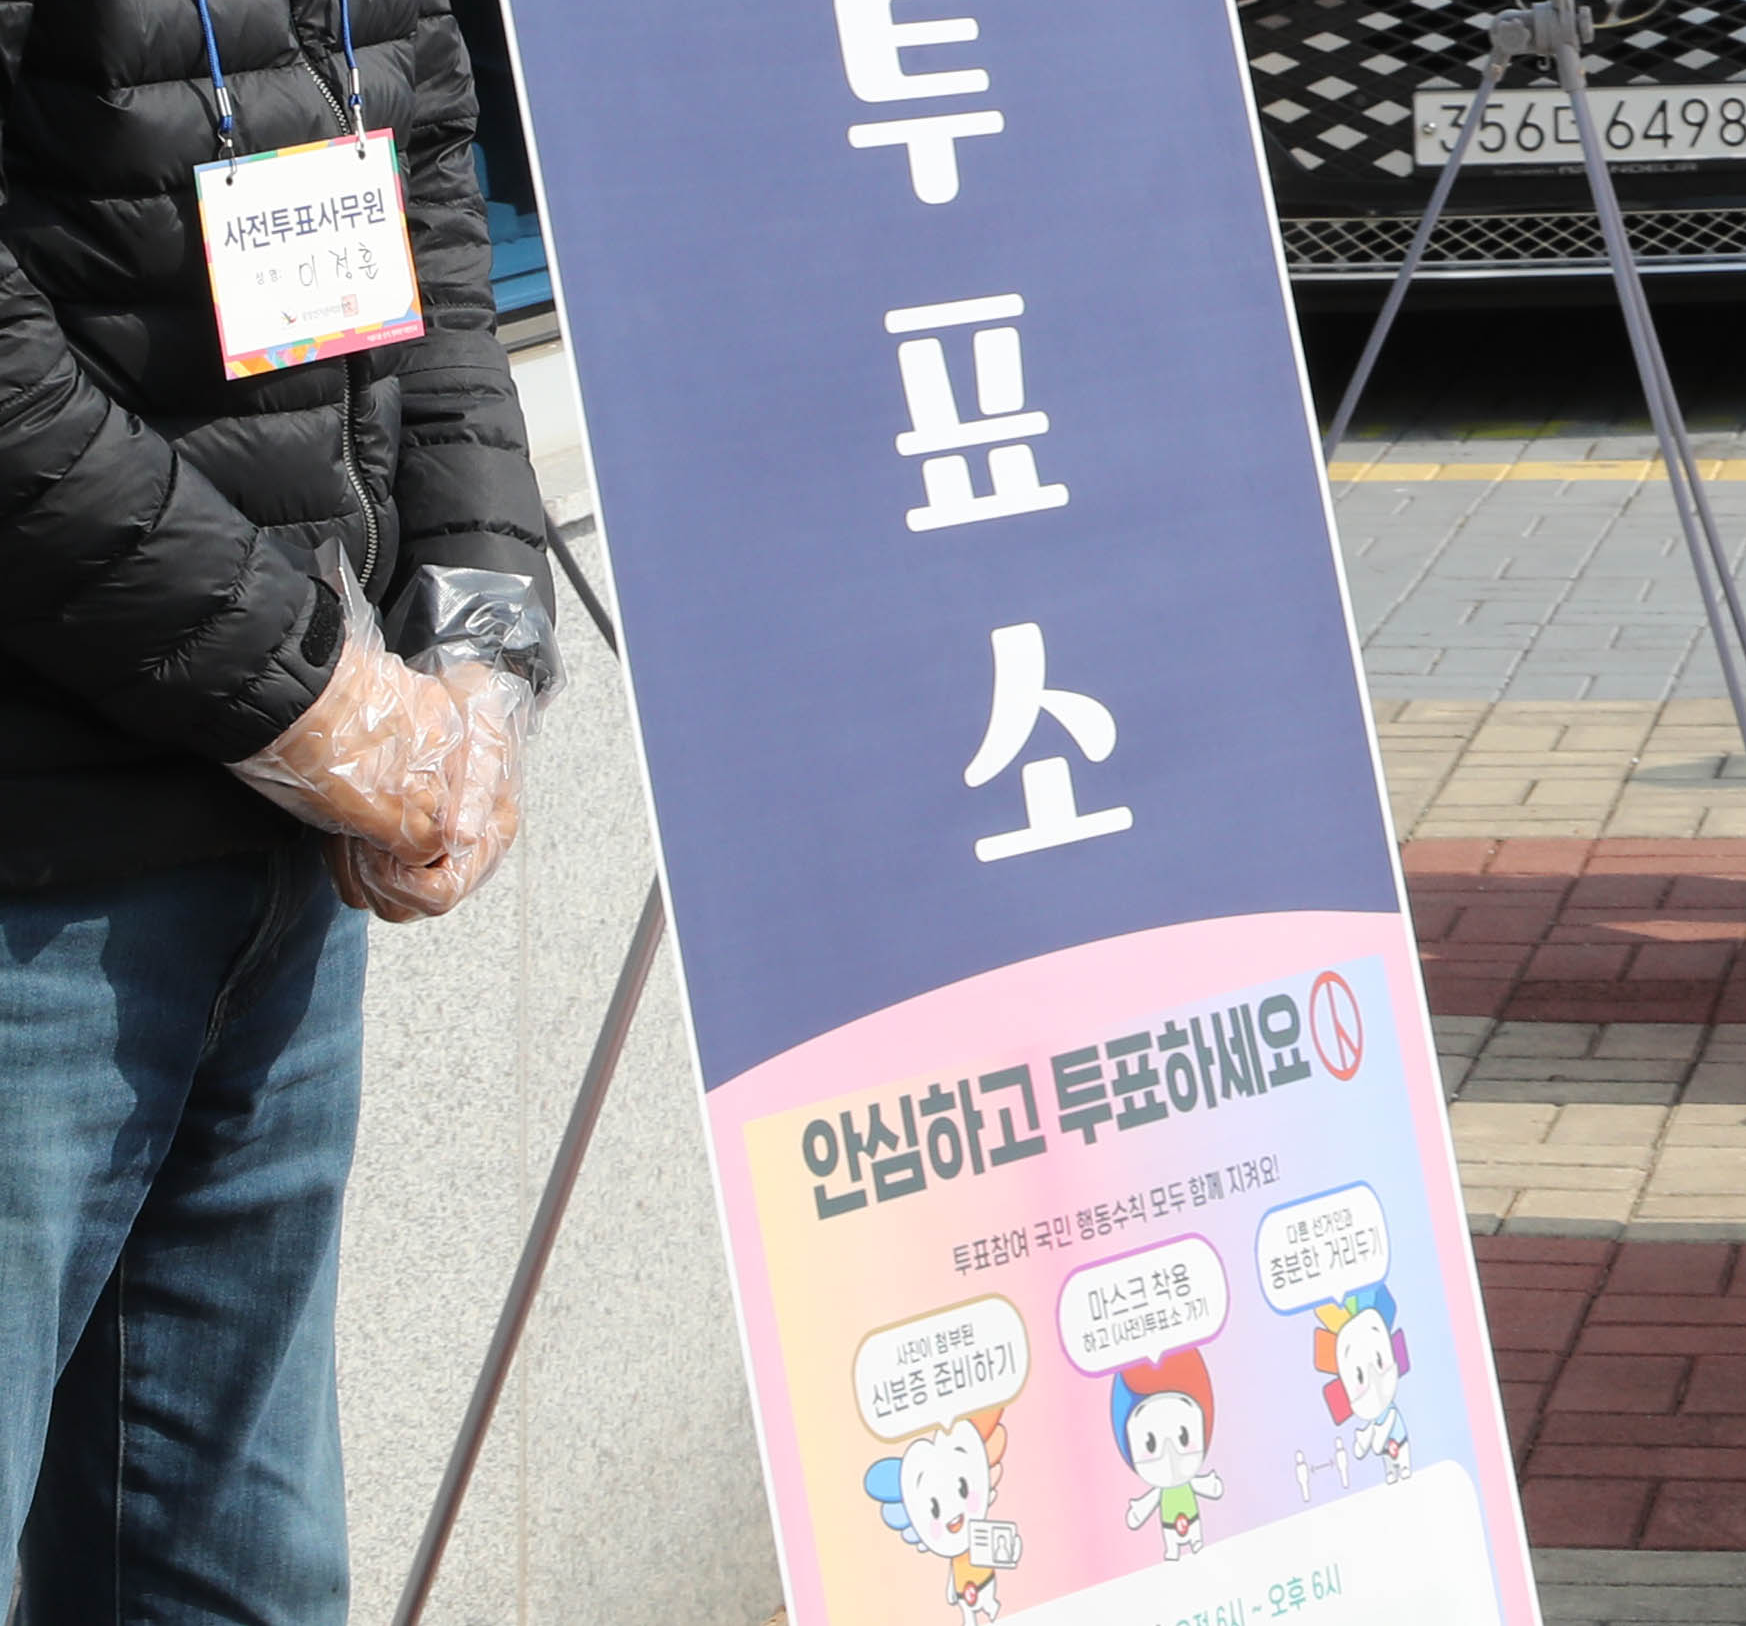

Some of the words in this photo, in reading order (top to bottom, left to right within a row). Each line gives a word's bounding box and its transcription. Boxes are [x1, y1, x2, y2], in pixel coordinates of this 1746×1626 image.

[223, 187, 387, 252] 사전투표사무원
[801, 1062, 1048, 1221] 안심하고
[1049, 993, 1313, 1146] 투표하세요
[952, 1227, 1030, 1277] 투표참여
[1034, 1215, 1073, 1251] 국민
[1076, 1193, 1146, 1241] 행동수칙
[1150, 1181, 1187, 1219] 모두
[1187, 1171, 1225, 1207] 함께
[1227, 1154, 1281, 1194] 지켜요!
[1286, 1220, 1311, 1244] 다른
[1312, 1207, 1353, 1239] 선거인과
[1270, 1245, 1322, 1290] 충분한
[1324, 1225, 1384, 1270] 거리두기
[1087, 1276, 1149, 1321] 마스크
[1151, 1263, 1192, 1301] 착용
[896, 1335, 933, 1366] 사진이
[934, 1323, 975, 1355] 첨부된
[1082, 1327, 1111, 1353] 하고
[1111, 1306, 1183, 1346] (사전)투표소
[1184, 1296, 1210, 1322] 가기
[872, 1369, 929, 1418] 신분증
[933, 1341, 1017, 1398] 준비하기
[1268, 1576, 1307, 1617] 오후
[1311, 1563, 1343, 1601] 6시
